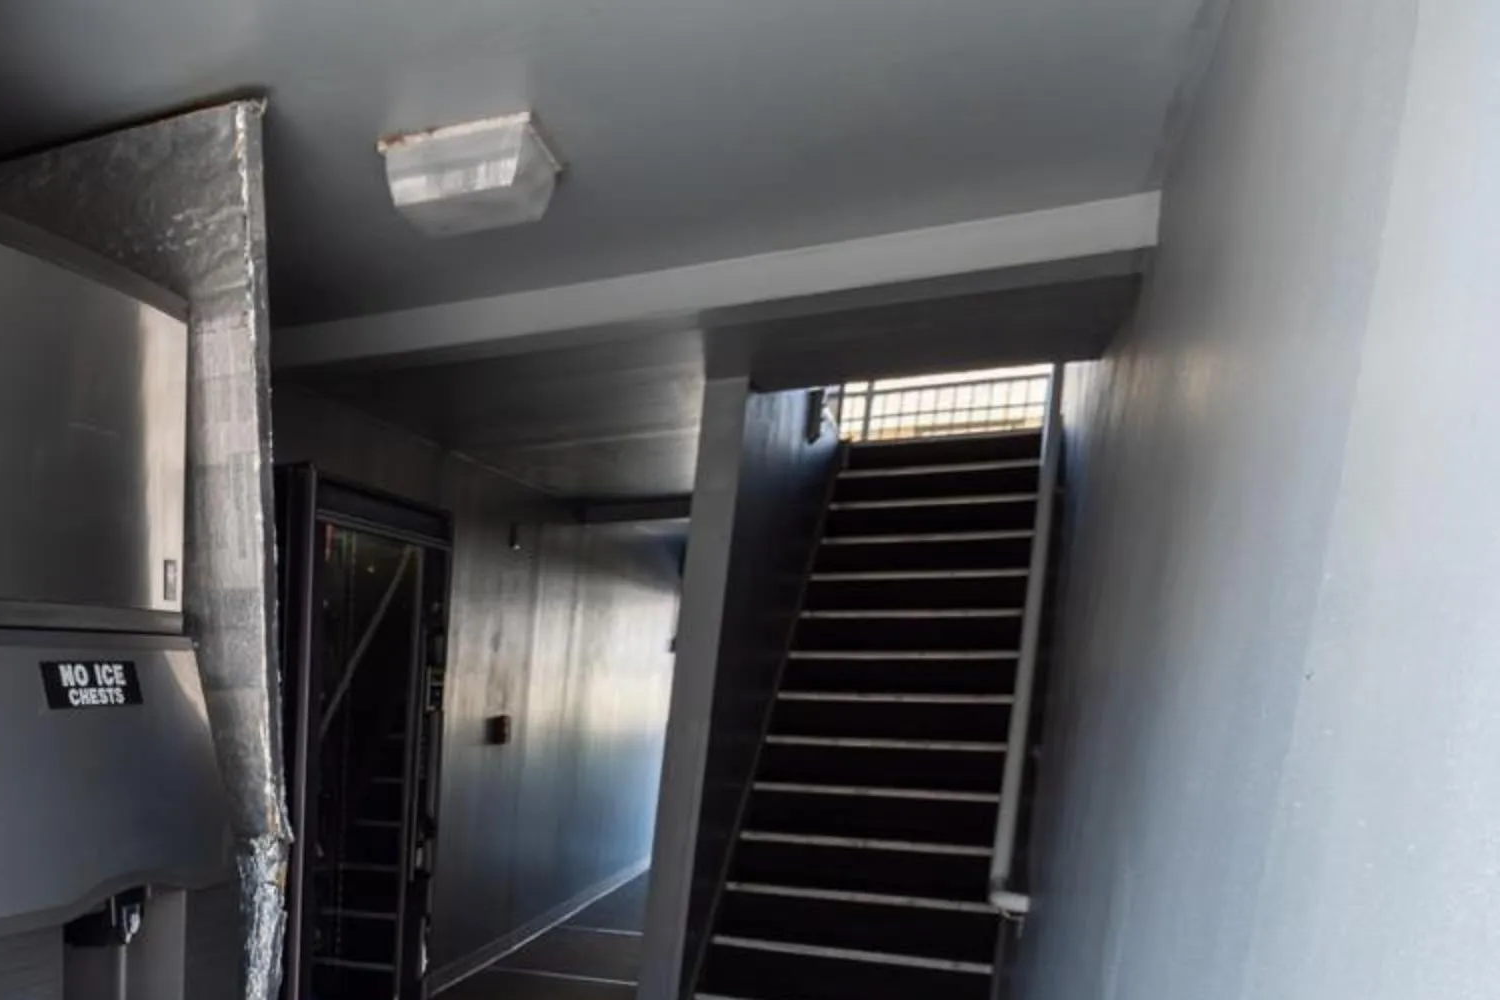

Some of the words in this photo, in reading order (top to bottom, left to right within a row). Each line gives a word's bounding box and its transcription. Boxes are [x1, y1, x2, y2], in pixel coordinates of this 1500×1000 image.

[58, 663, 90, 687] NO
[93, 663, 126, 686] ICE
[68, 687, 125, 706] CHESTS
